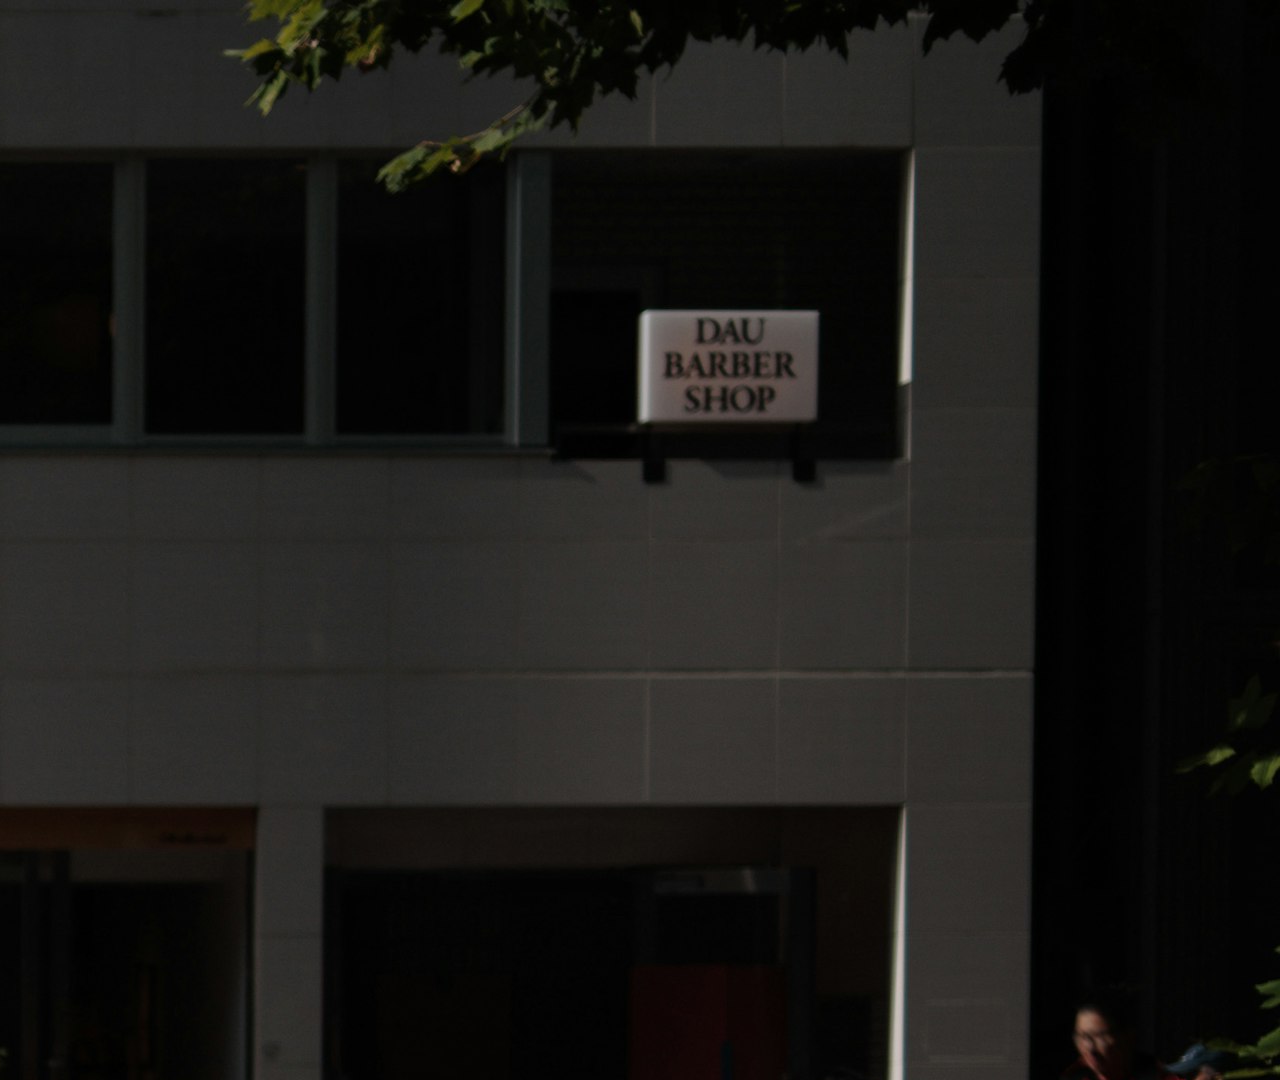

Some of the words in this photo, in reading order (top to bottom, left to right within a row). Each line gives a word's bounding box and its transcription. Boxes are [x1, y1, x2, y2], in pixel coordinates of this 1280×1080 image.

[696, 317, 765, 345] DAU
[664, 351, 795, 379] BARBER
[684, 385, 775, 413] SHOP
